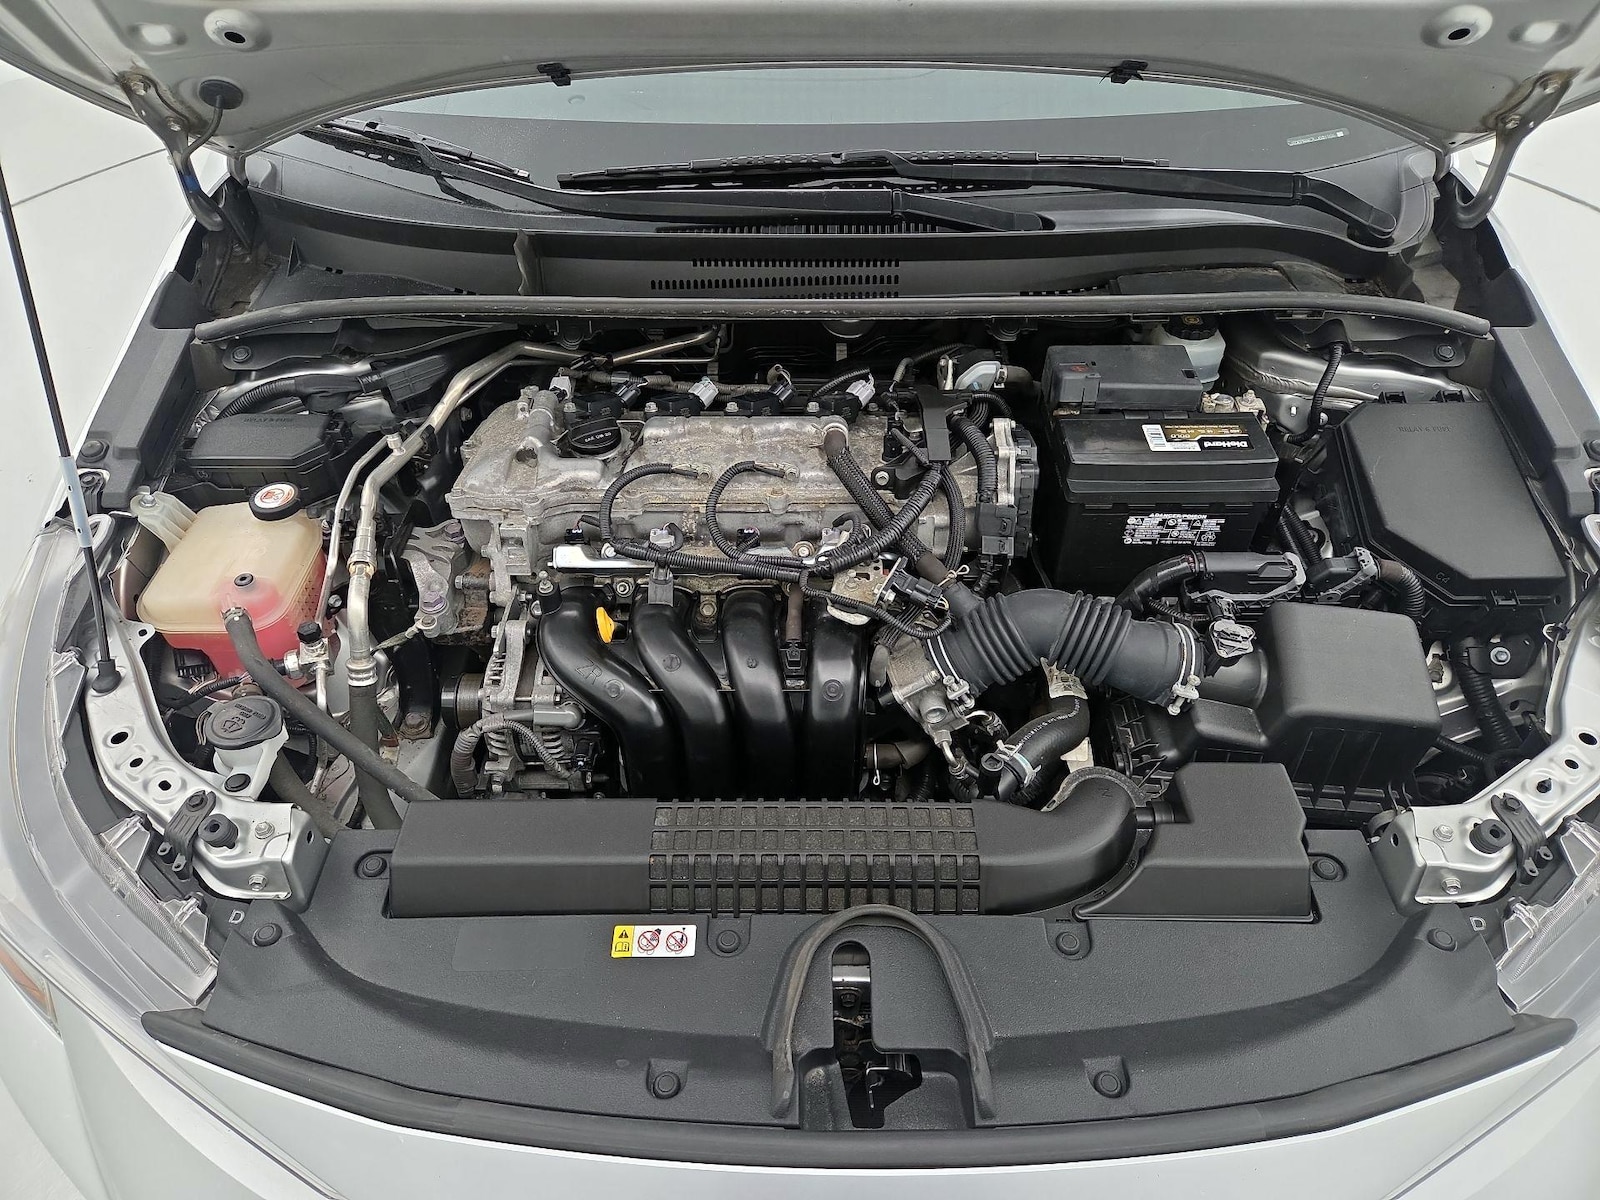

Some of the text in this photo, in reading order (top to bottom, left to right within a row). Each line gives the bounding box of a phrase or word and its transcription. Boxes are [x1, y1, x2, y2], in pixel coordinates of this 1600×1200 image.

[1203, 440, 1249, 448] DieHard
[228, 908, 245, 924] D
[1469, 916, 1487, 932] D
